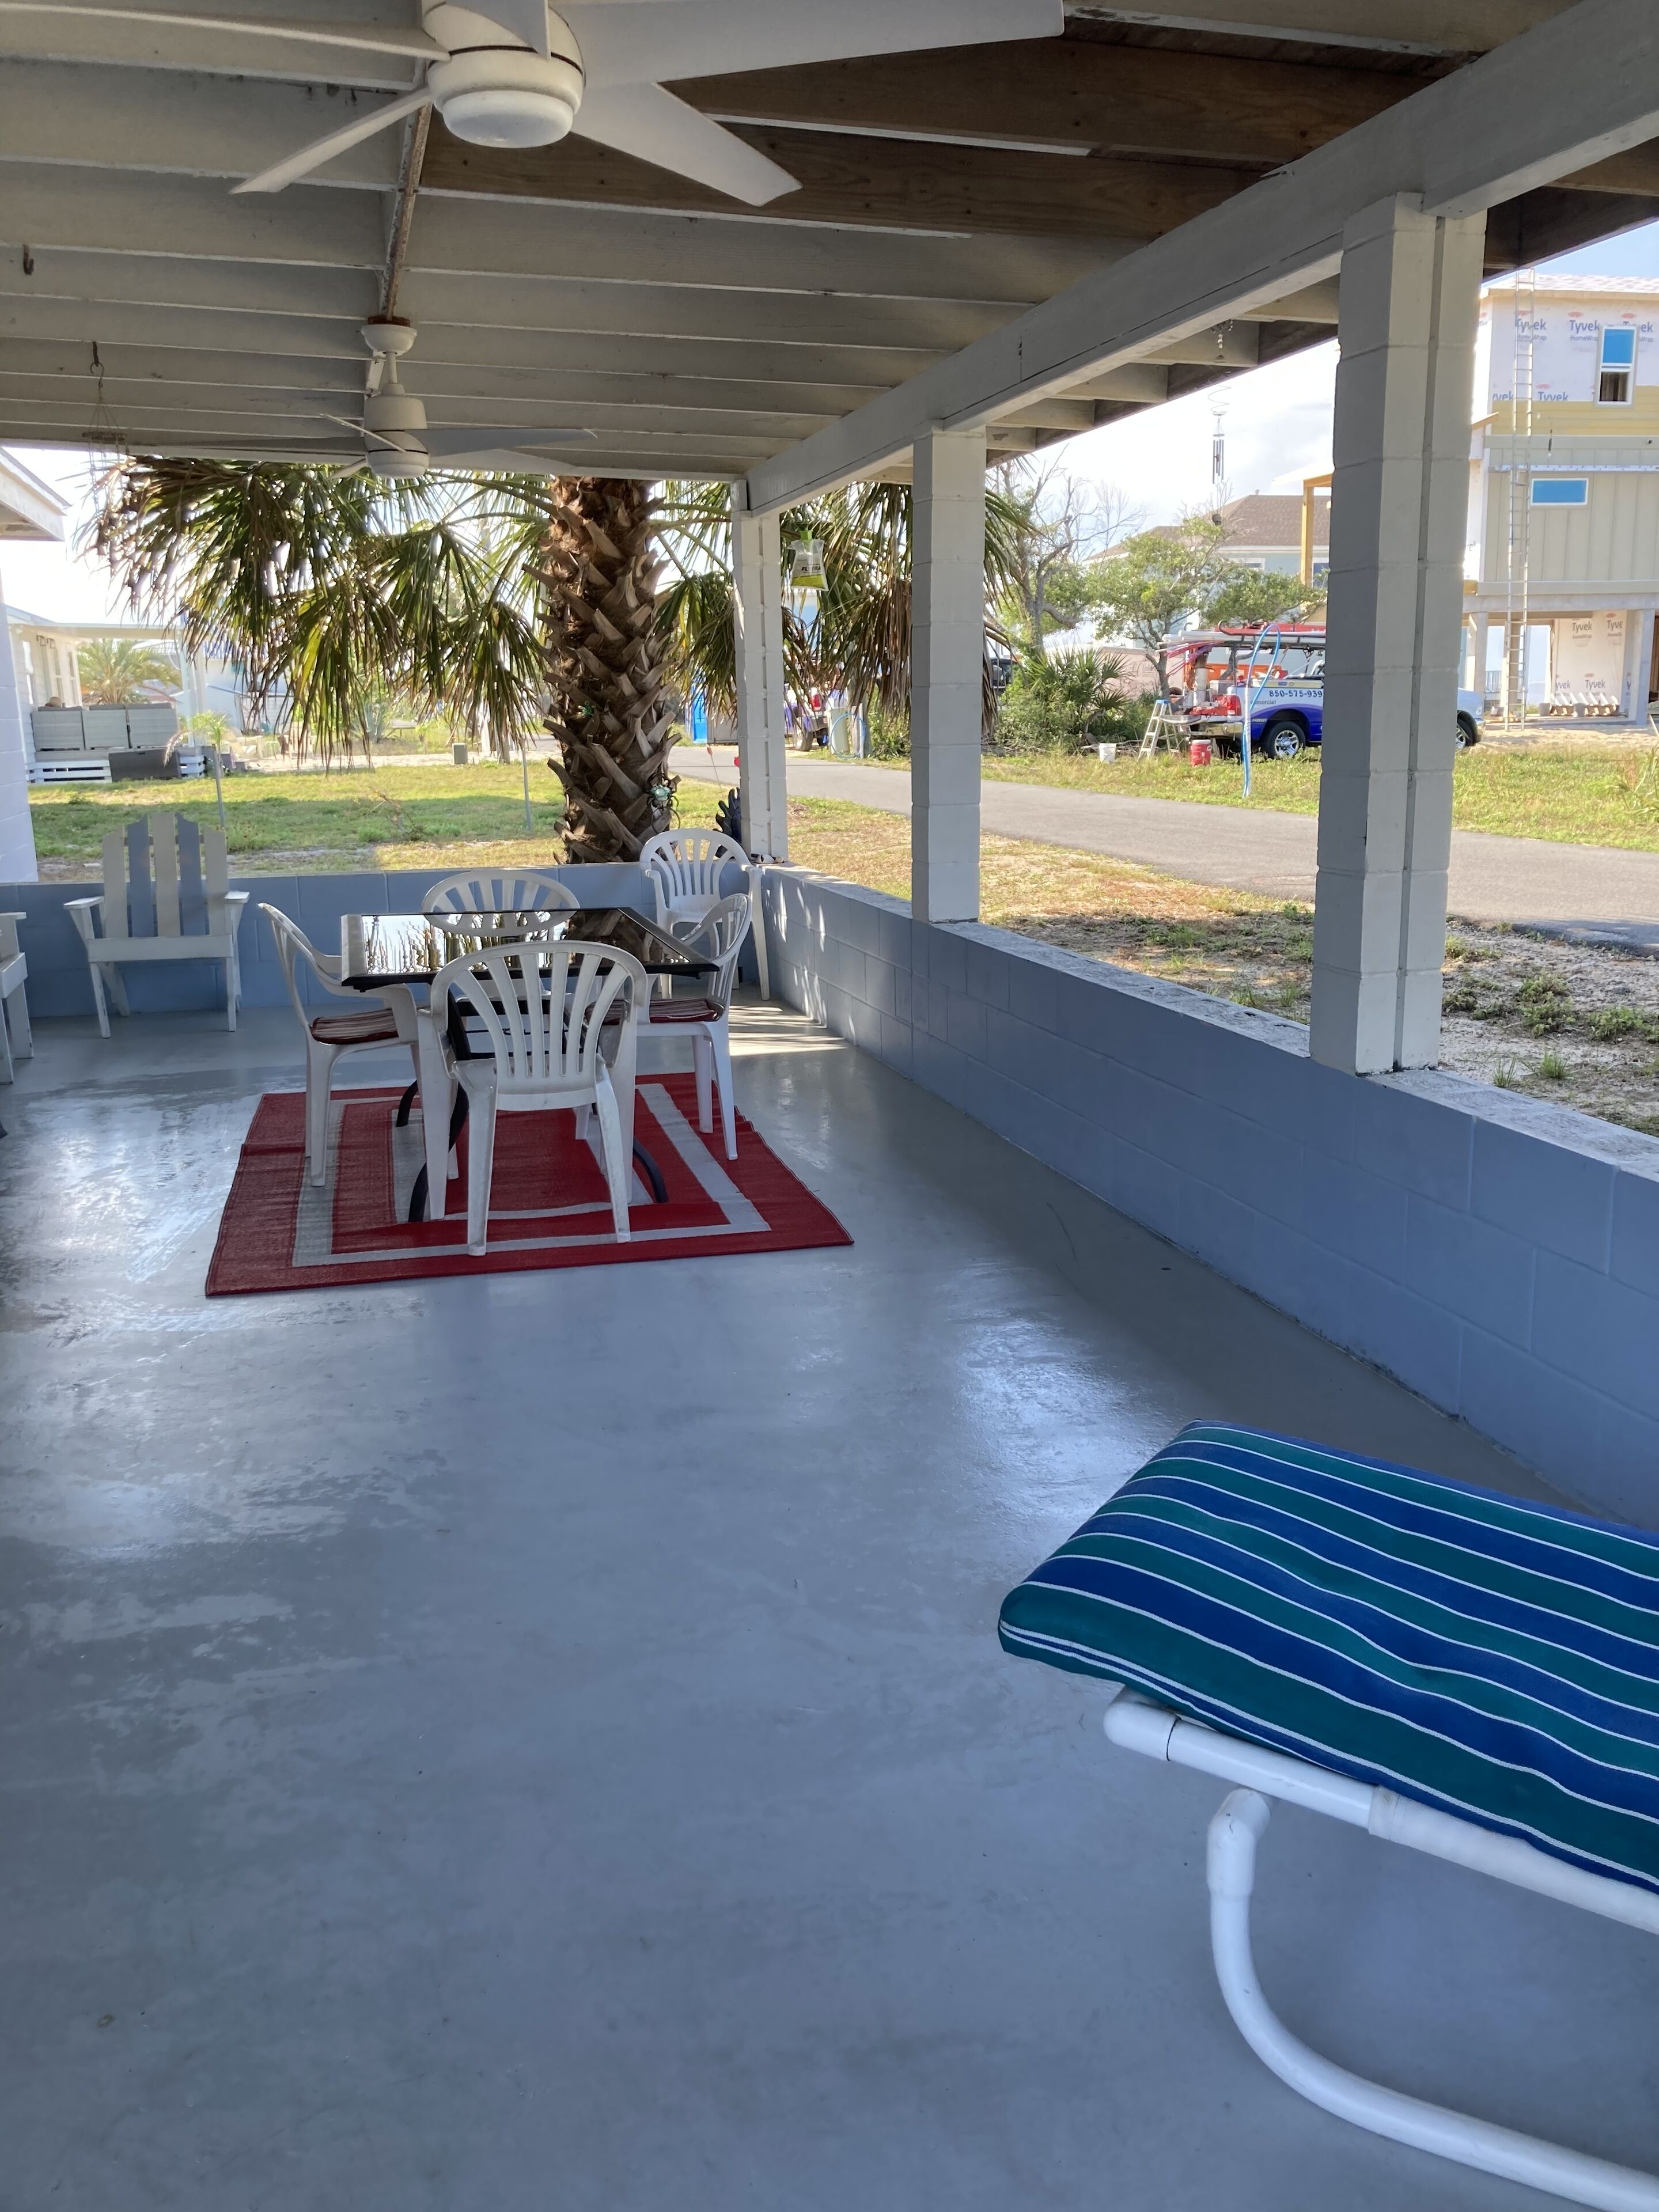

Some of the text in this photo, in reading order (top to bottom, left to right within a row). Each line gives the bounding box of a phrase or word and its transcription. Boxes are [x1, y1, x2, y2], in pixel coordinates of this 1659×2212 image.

[1569, 320, 1600, 334] Tyvek
[1572, 621, 1592, 634] Tyvek
[1607, 620, 1623, 631] Tyve
[1555, 680, 1571, 691] yvek
[1585, 679, 1606, 691] Tyvek
